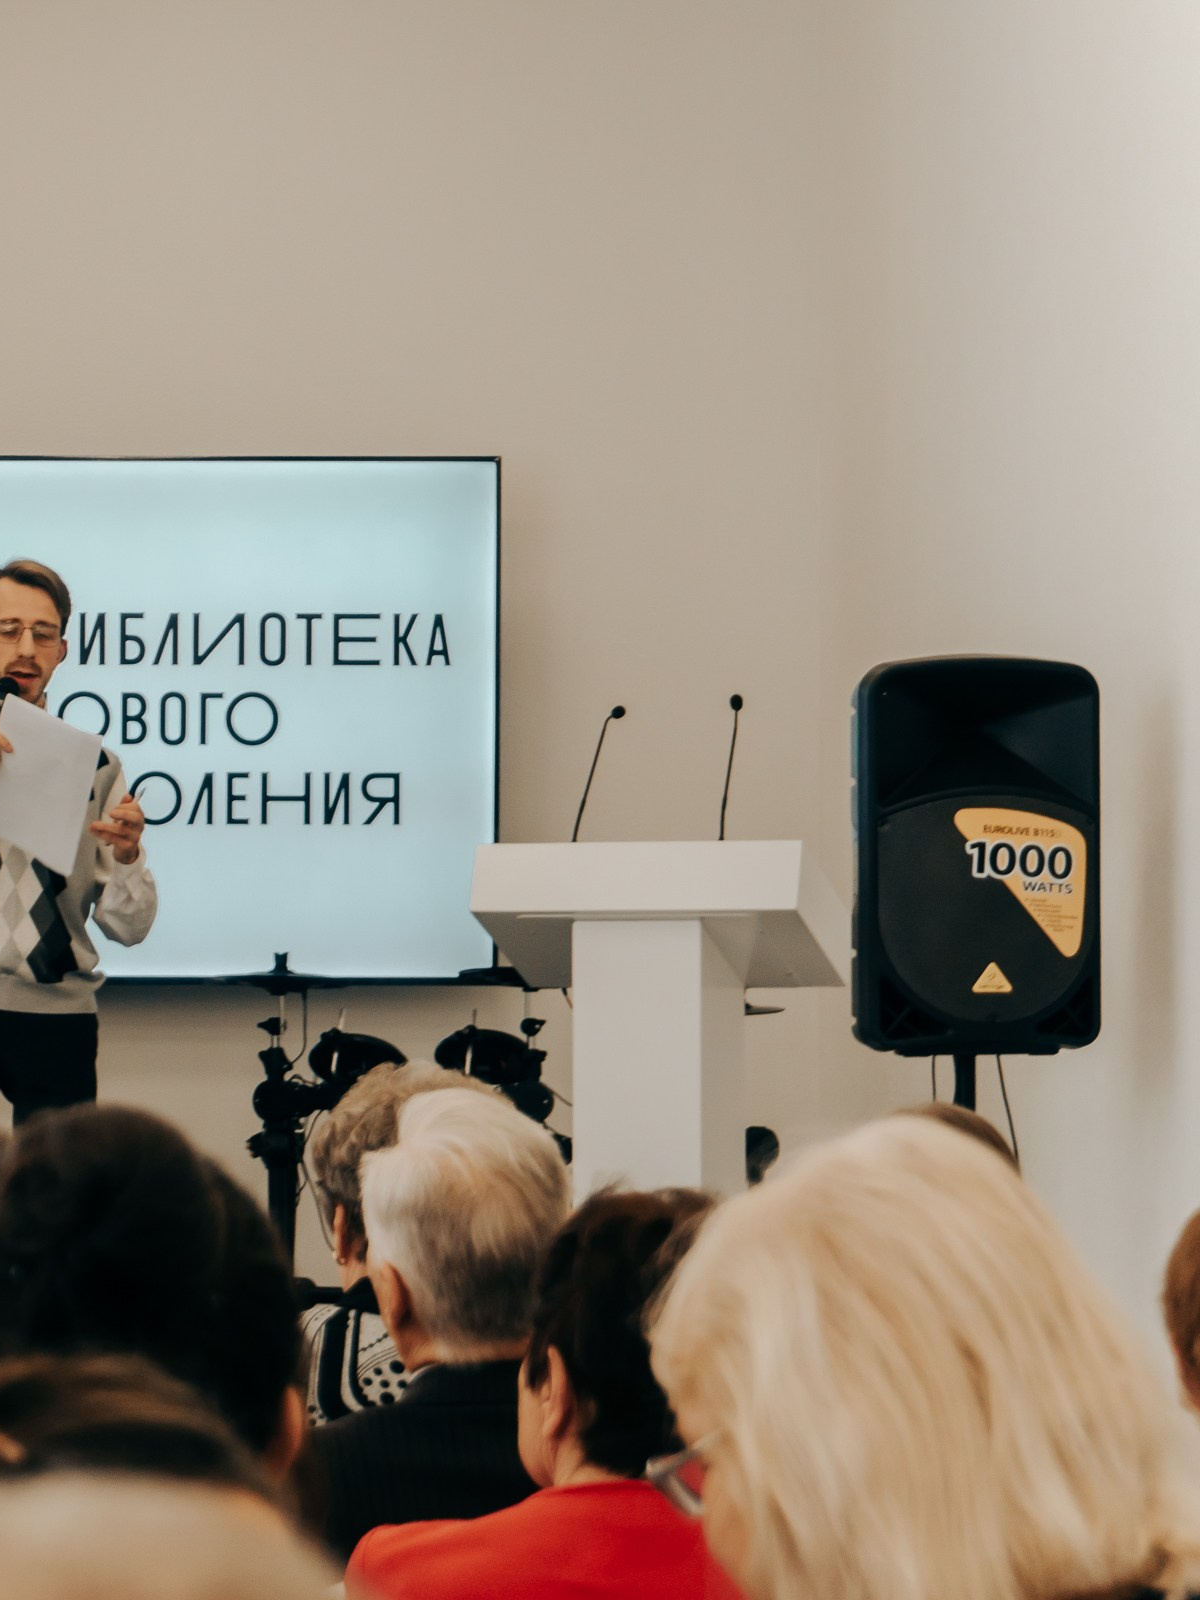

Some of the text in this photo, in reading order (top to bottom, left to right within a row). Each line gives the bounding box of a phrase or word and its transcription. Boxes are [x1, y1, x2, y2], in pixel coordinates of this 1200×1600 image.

[78, 611, 451, 667] ИБЛИОТЕКА
[57, 690, 279, 746] ОВОГО
[129, 770, 400, 826] ОЛЕНИЯ
[968, 841, 1073, 880] 1000
[1023, 881, 1073, 894] WATTS
